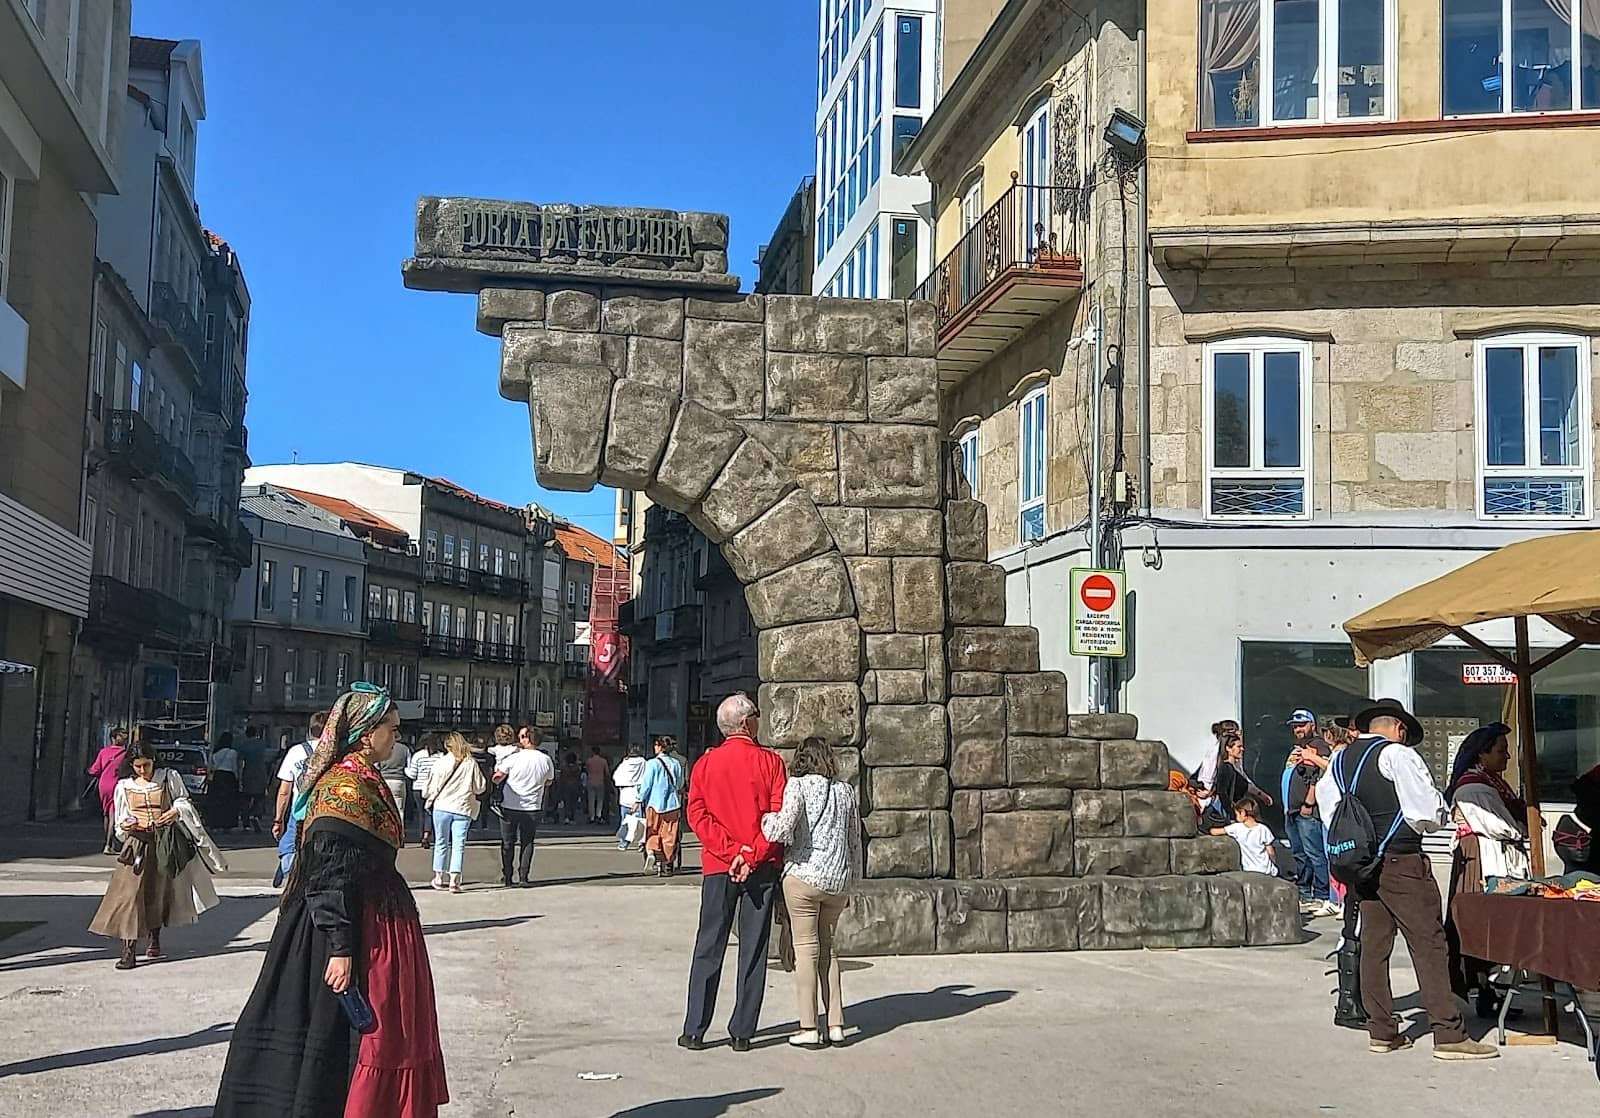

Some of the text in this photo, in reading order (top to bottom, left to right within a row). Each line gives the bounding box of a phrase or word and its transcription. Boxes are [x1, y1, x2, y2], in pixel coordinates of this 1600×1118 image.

[460, 206, 692, 258] PORTA DA FALPERRA
[1465, 666, 1480, 676] 607
[1482, 666, 1497, 676] 357
